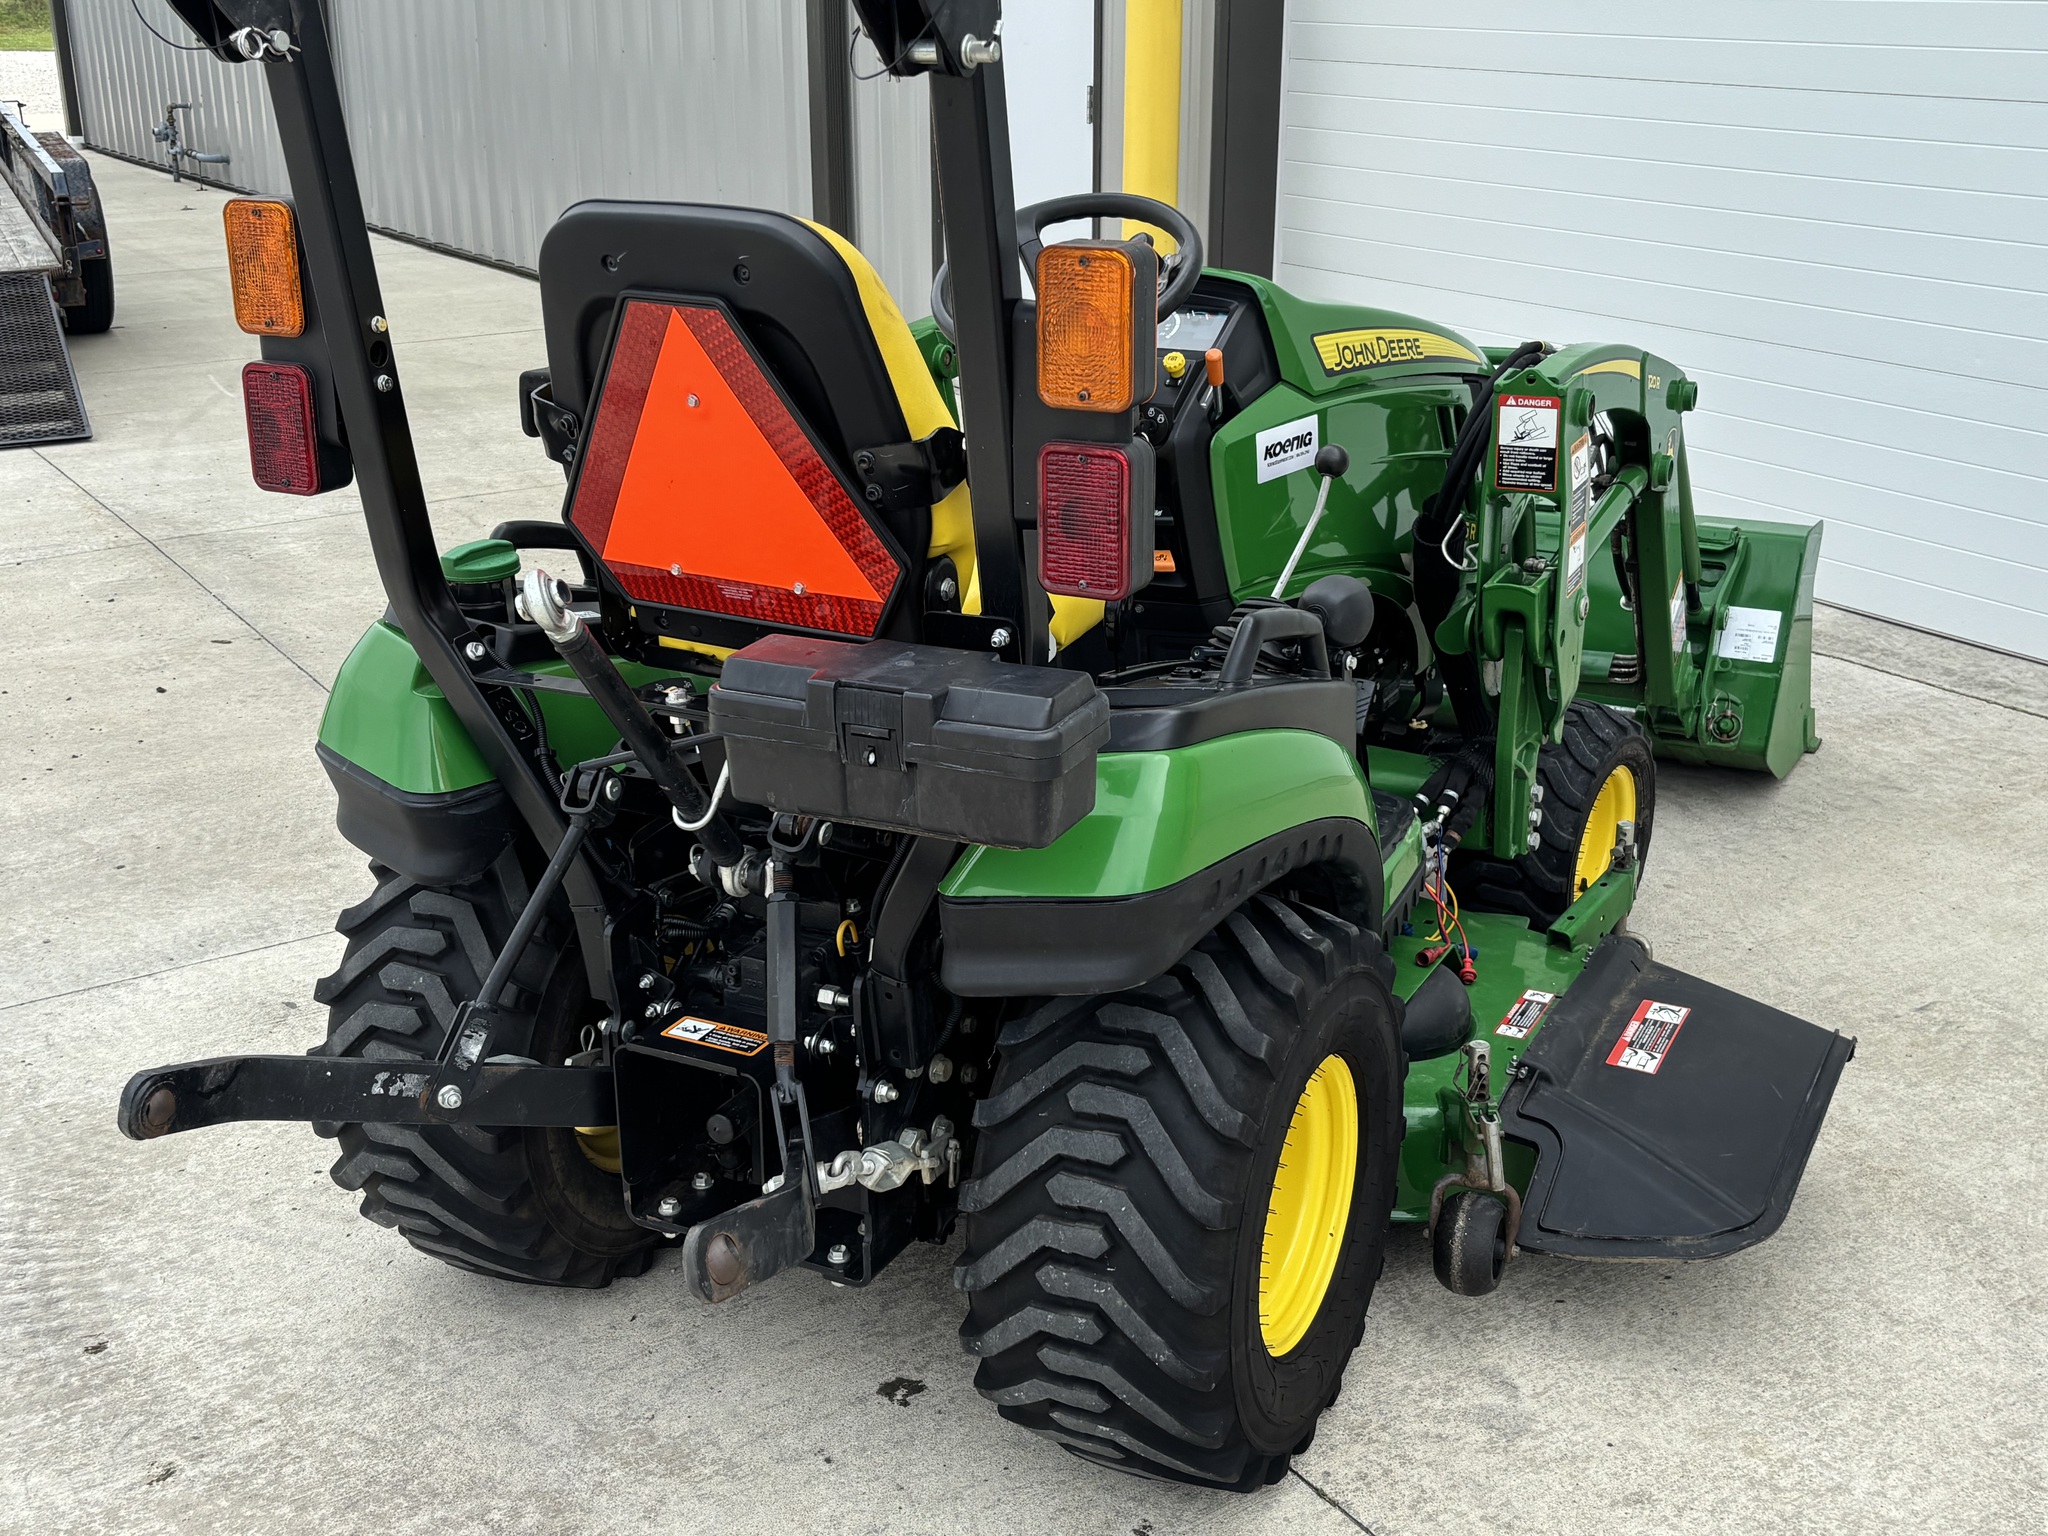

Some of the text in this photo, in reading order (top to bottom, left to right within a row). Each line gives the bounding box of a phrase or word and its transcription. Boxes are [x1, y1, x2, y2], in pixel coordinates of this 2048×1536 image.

[1334, 336, 1424, 367] JOHN DEERE
[1517, 398, 1552, 407] DANGER
